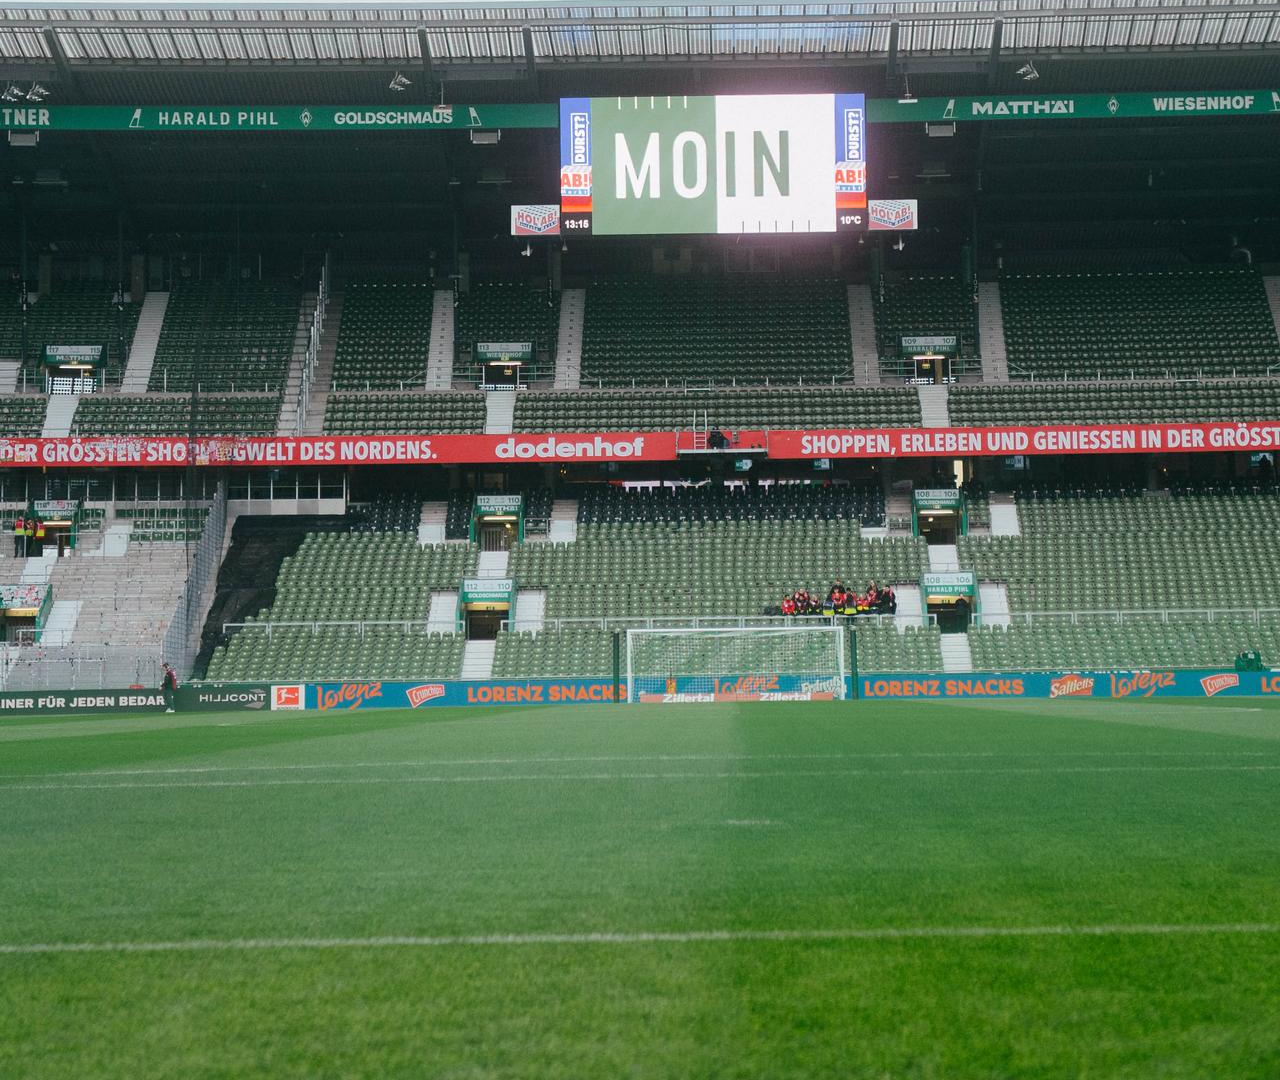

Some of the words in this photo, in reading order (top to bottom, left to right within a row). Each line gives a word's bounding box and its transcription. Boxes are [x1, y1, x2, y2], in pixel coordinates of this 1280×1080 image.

[972, 100, 1074, 115] MATTHÄI
[1152, 96, 1255, 112] WIESENHOF
[158, 111, 231, 126] HARALD
[237, 111, 278, 126] PIHL
[334, 109, 453, 124] GOLDSCHMAUS
[574, 116, 586, 163] DURST?
[848, 112, 860, 159] DURST?
[615, 129, 790, 200] MOIN
[0, 442, 37, 463] DER
[42, 438, 141, 463] GRÖSSTEN
[303, 441, 335, 462] DES
[340, 440, 438, 461] NORDENS.
[495, 437, 645, 458] dodenhof
[801, 434, 897, 455] SHOPPEN,
[901, 432, 982, 453] ERLEBEN
[987, 431, 1029, 452] UND
[1033, 430, 1136, 451] GENIESSEN
[1140, 428, 1163, 449] IN
[1167, 428, 1205, 449] DER
[467, 685, 544, 703] LORENZ
[548, 683, 626, 701] SNACKS
[864, 680, 940, 697] LORENZ
[945, 679, 1024, 696] SNACKS
[1110, 671, 1176, 698] Lorenz
[38, 694, 66, 709] FÜR
[70, 696, 116, 708] JEDEN
[119, 695, 165, 707] BEDAR
[317, 681, 383, 711] Lorenz
[662, 693, 715, 703] Zillertal
[759, 691, 812, 701] Zillertal
